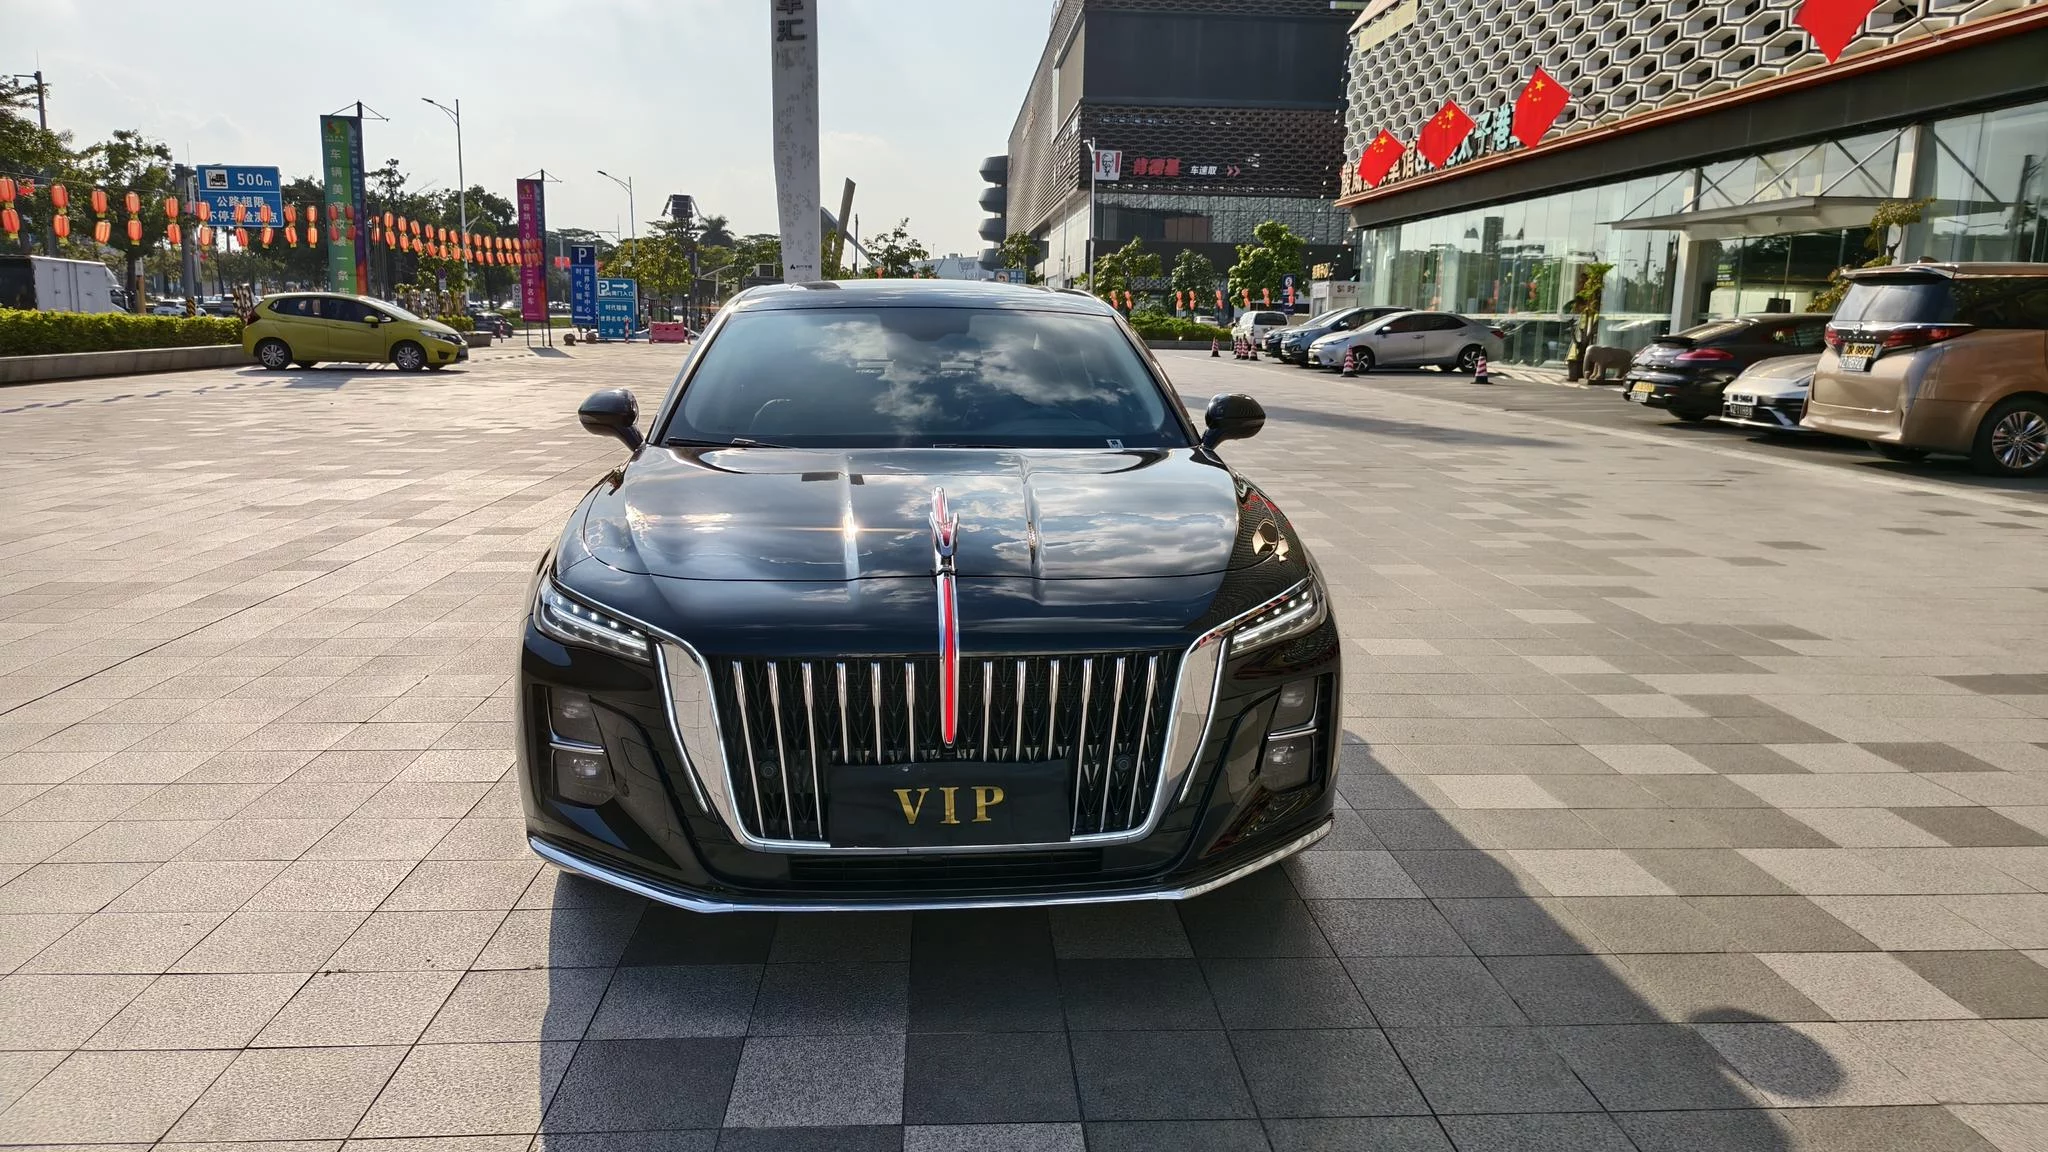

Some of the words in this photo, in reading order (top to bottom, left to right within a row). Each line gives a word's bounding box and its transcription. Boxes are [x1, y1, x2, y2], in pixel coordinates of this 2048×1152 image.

[237, 173, 272, 186] 500m
[578, 247, 587, 264] P
[893, 786, 1005, 825] VIP
